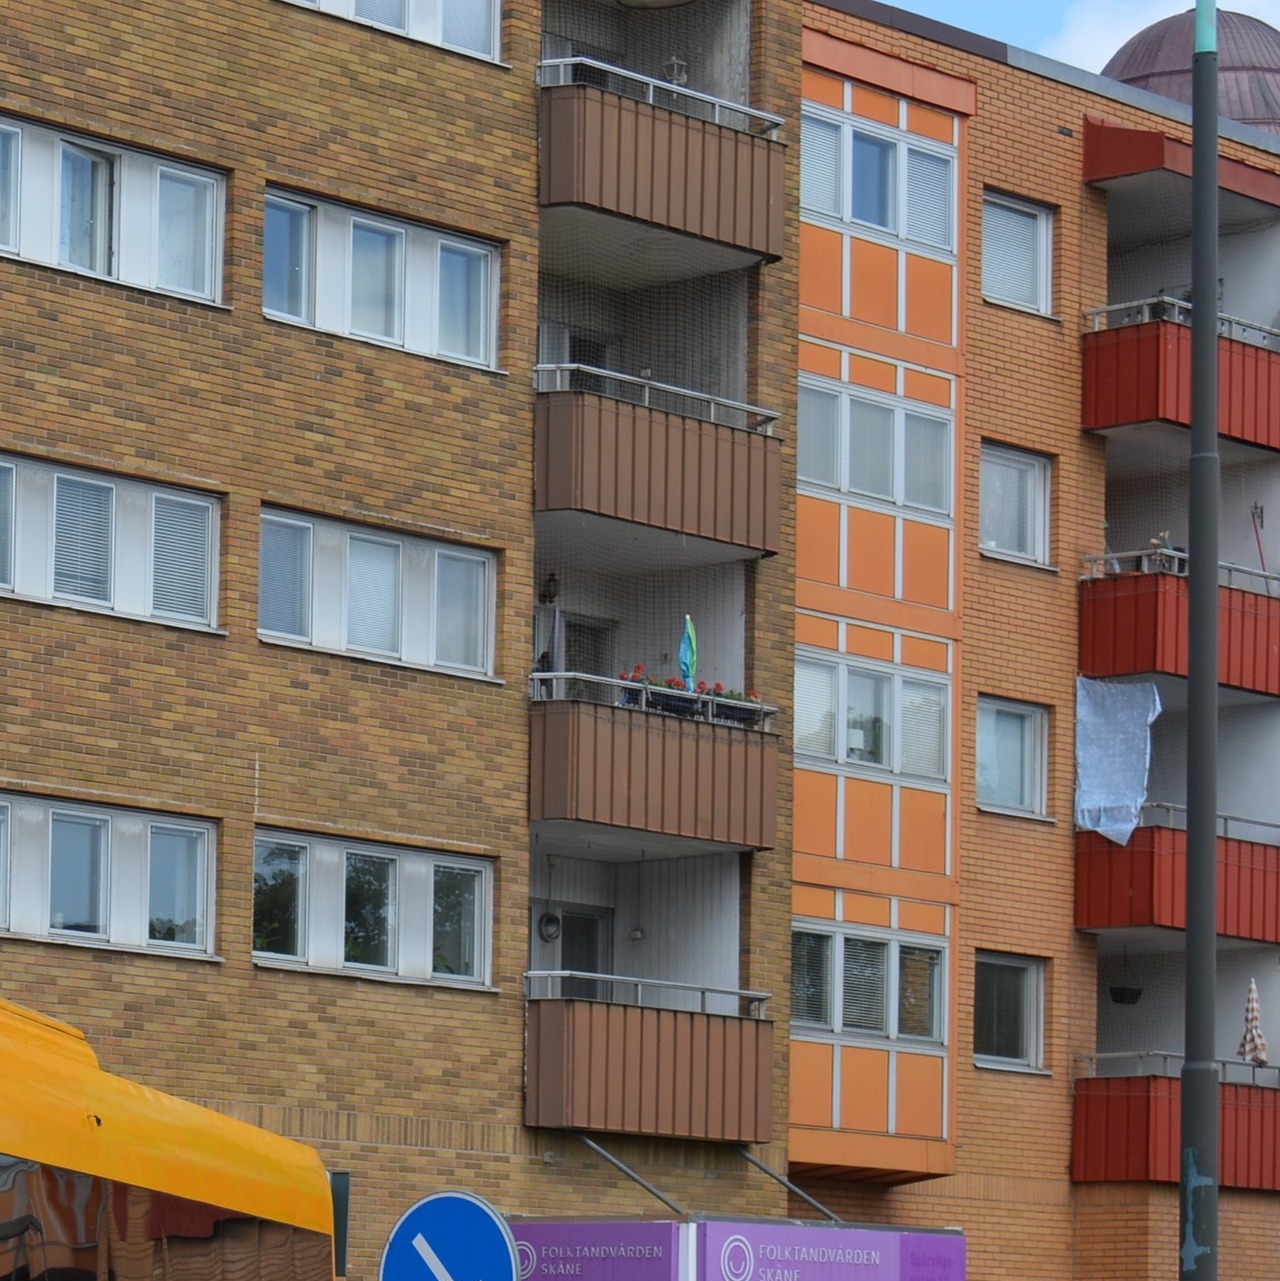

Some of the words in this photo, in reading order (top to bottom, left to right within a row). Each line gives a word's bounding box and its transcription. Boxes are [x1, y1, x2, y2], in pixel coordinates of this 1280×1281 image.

[542, 1243, 663, 1259] FOLKTANDVÅRDEN
[758, 1244, 881, 1266] FOLKTANDVÅRDEN
[541, 1261, 583, 1276] SKÅNE
